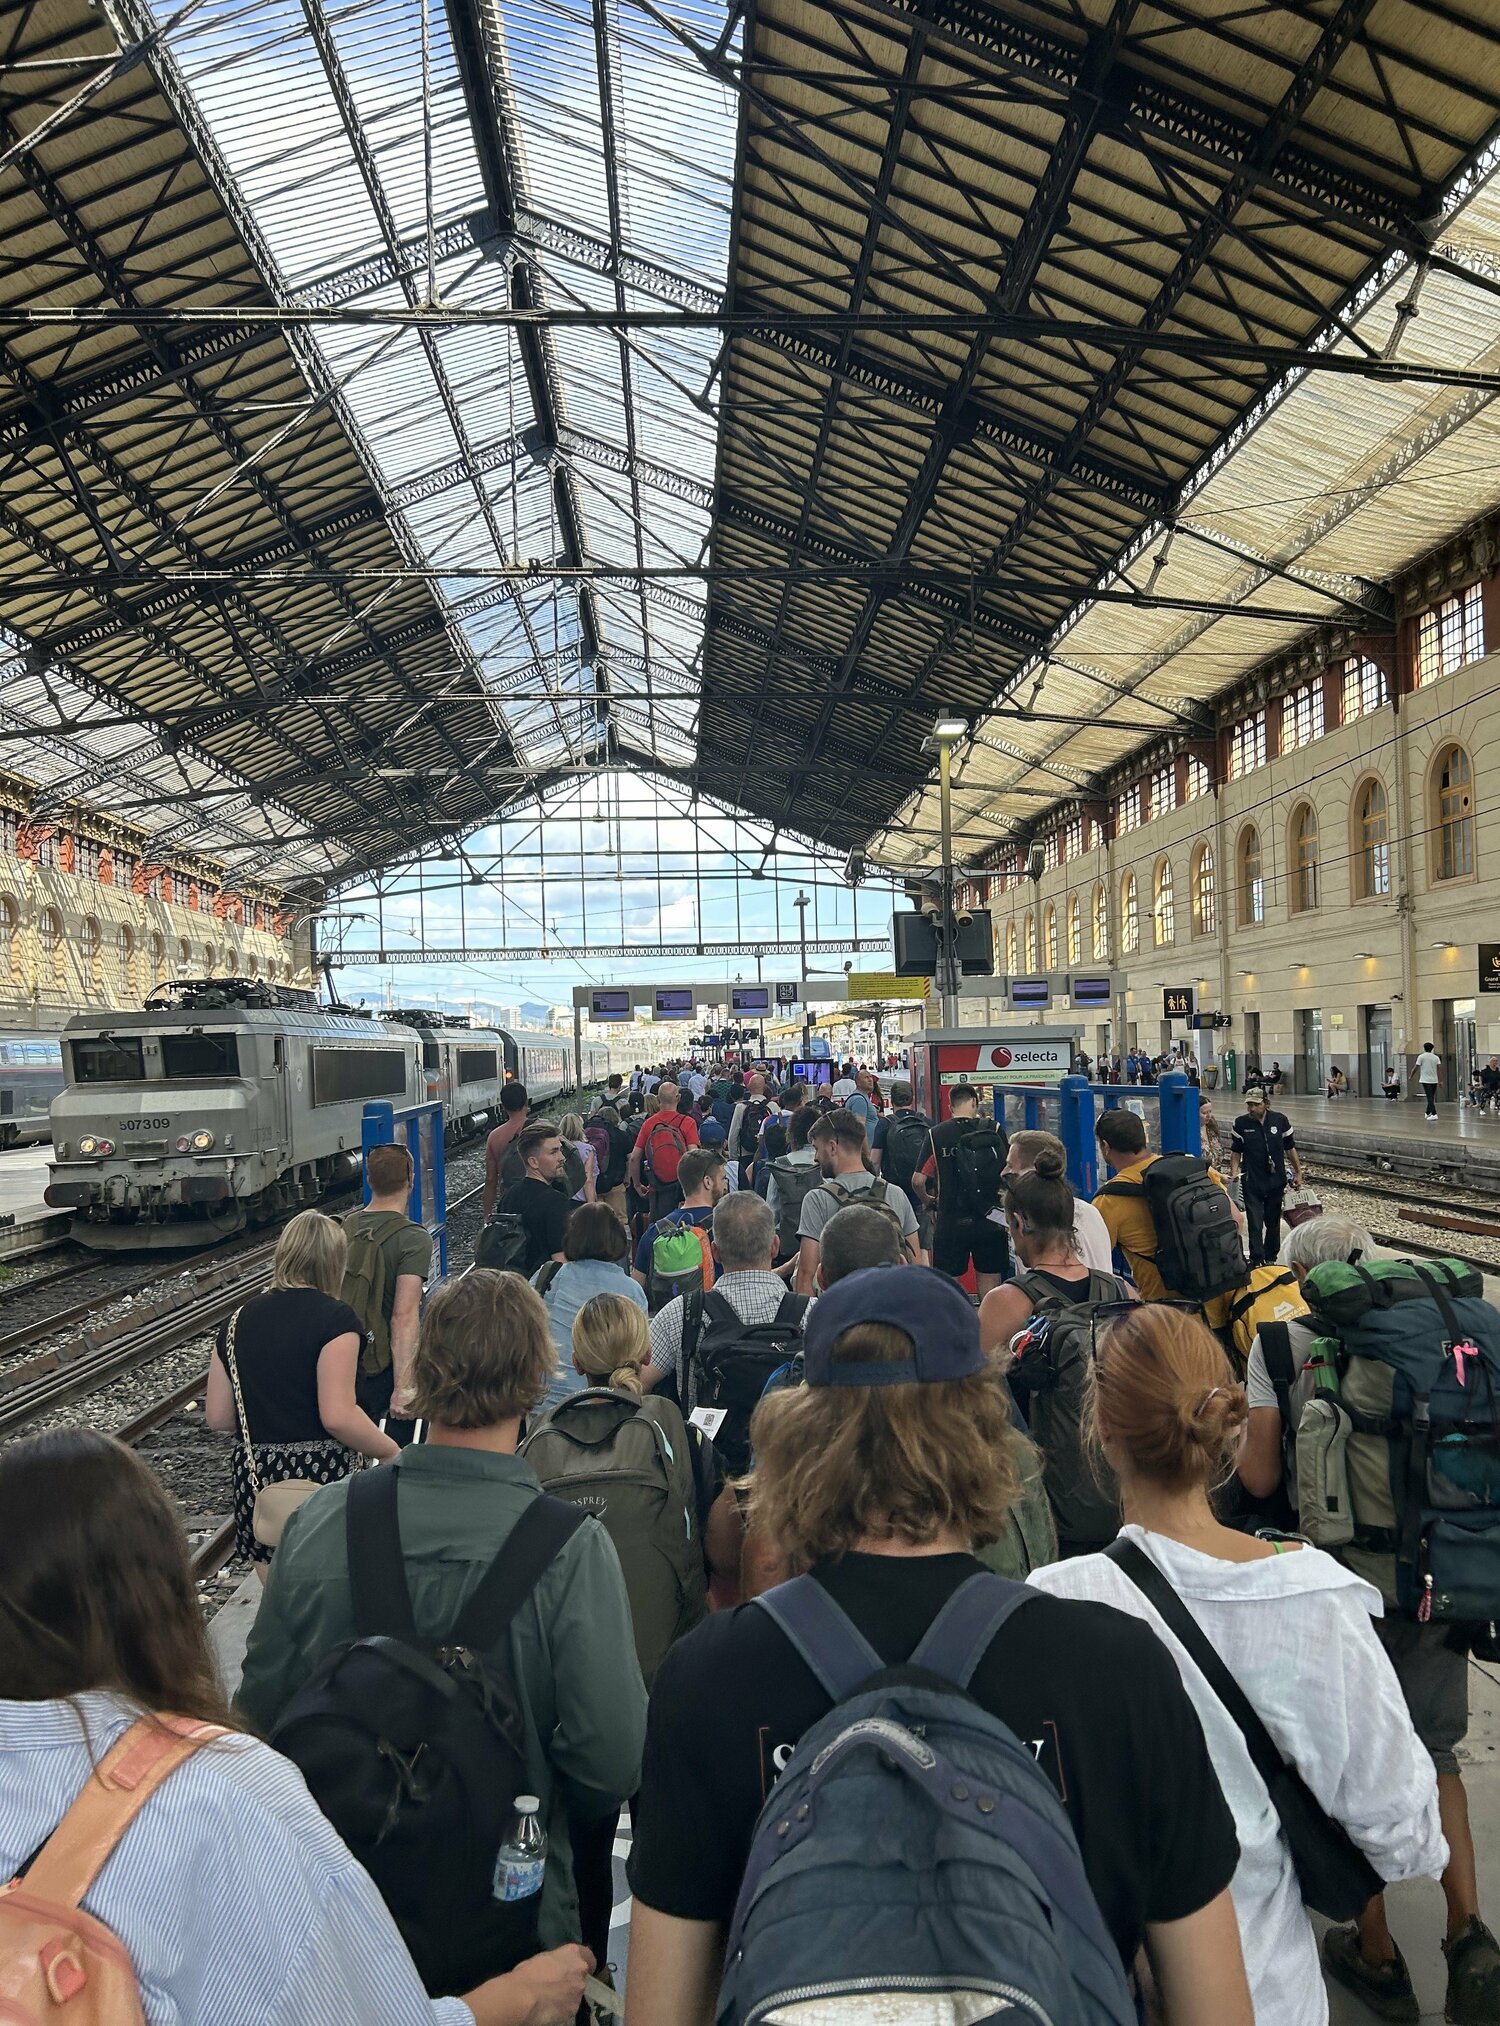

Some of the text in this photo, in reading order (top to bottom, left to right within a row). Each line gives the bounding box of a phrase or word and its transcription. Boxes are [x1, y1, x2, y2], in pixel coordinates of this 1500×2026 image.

[1222, 1017, 1229, 1026] Z
[729, 1031, 736, 1040] Z
[745, 1030, 751, 1039] Z
[1013, 1051, 1058, 1062] selecta
[119, 1118, 170, 1131] 507309
